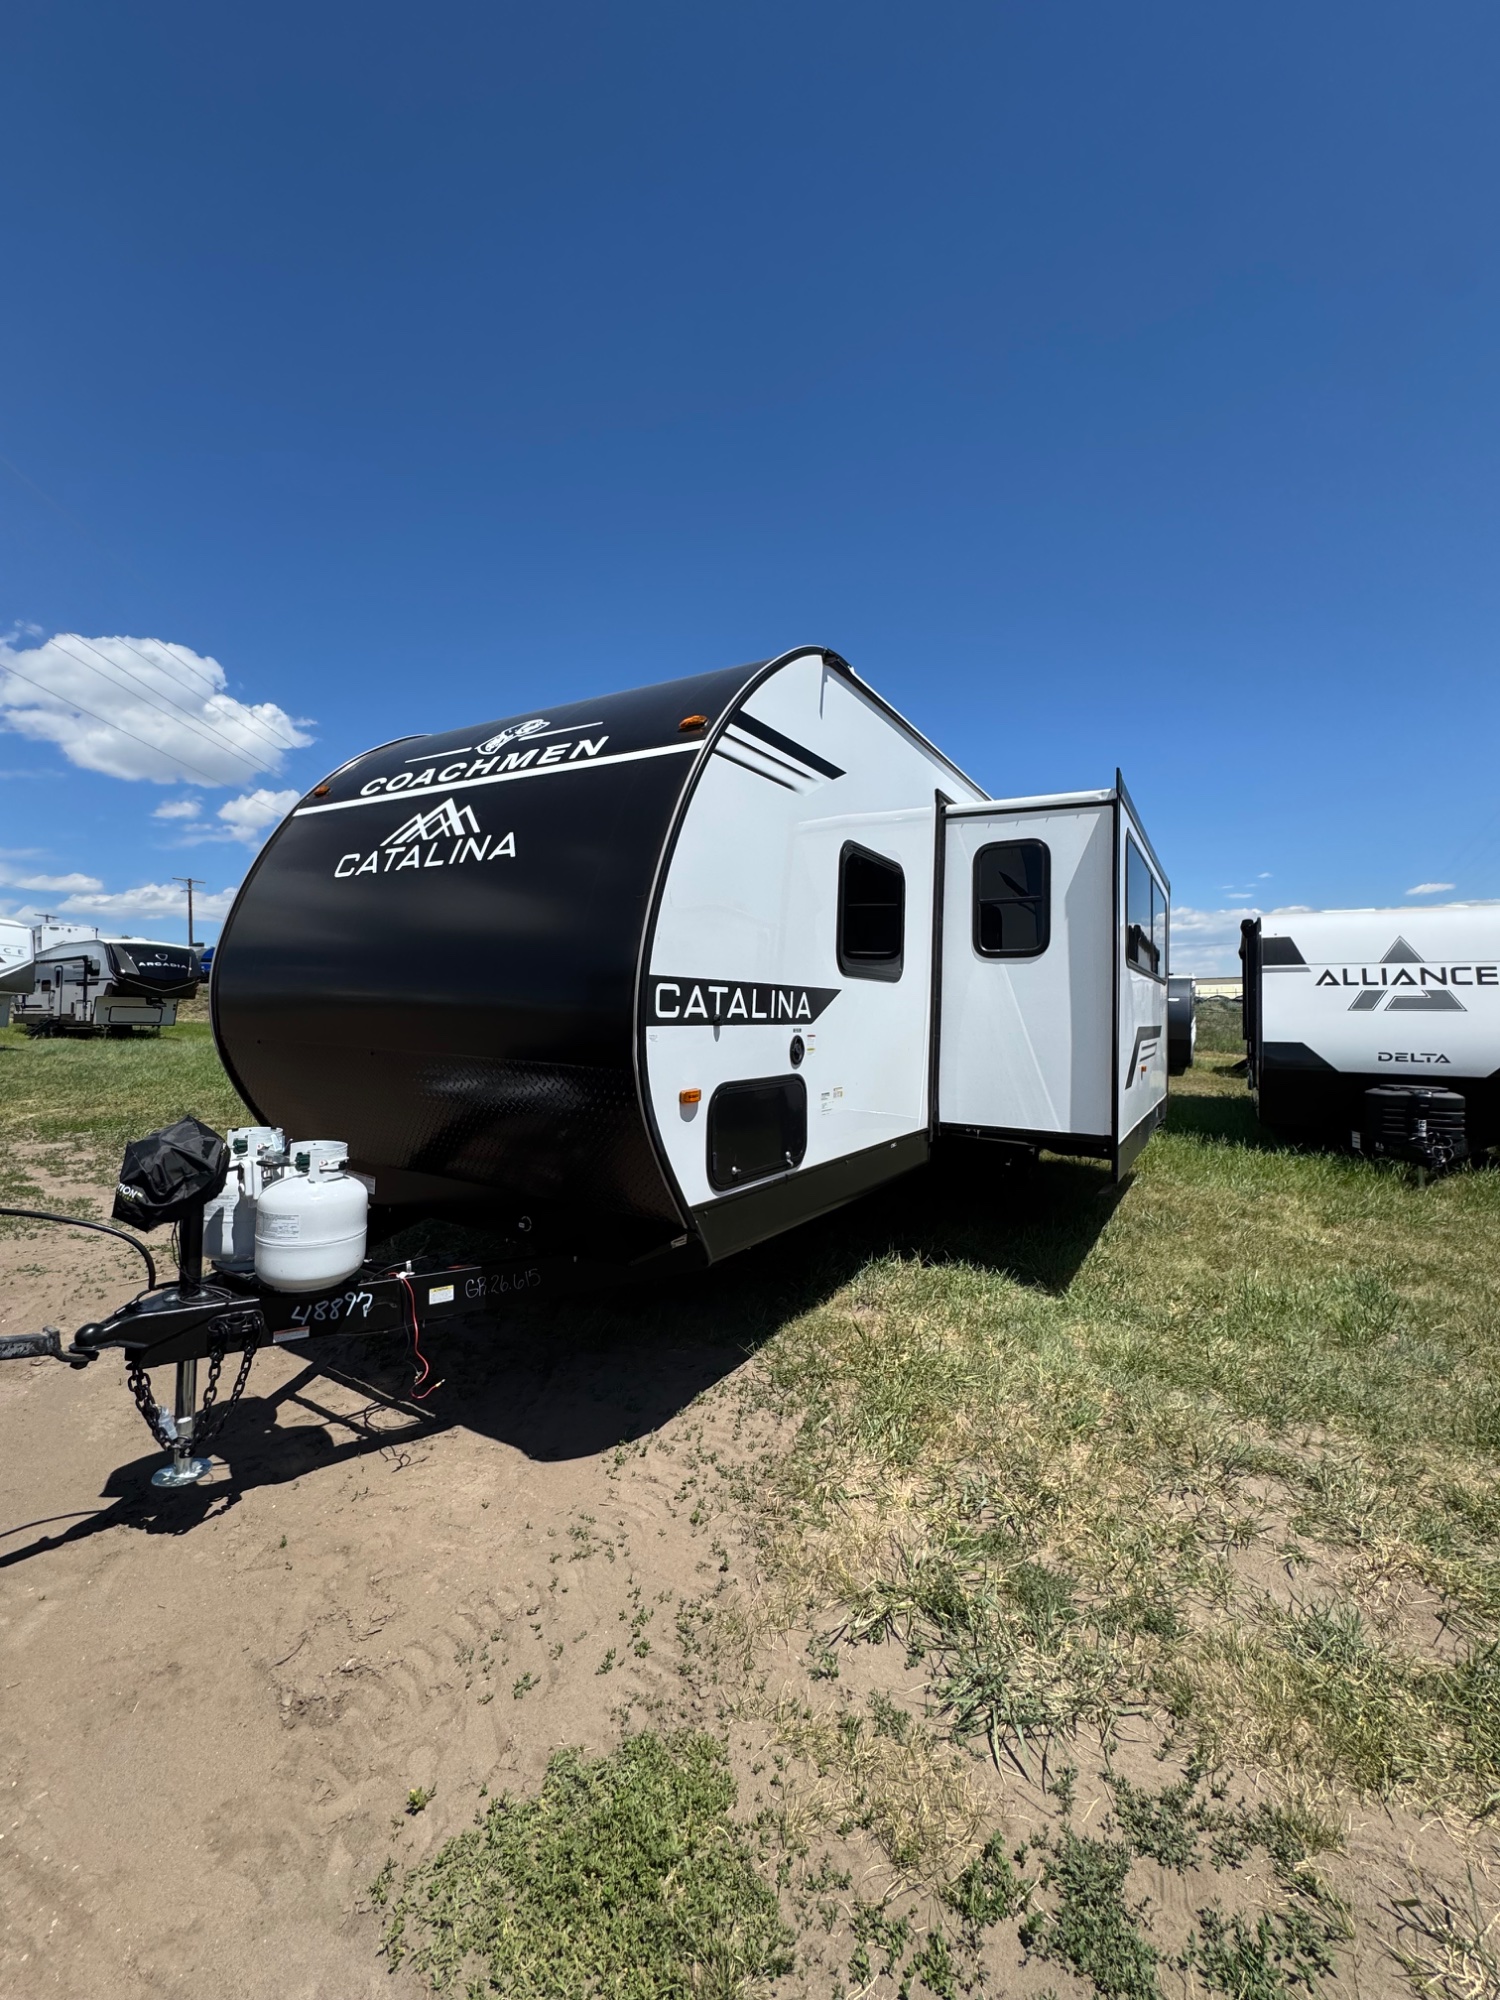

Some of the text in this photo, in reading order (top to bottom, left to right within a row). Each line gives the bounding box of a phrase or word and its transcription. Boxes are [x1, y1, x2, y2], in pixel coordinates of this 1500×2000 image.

[360, 736, 609, 796] COACHMEN
[334, 832, 516, 878] CATALINA
[138, 961, 188, 969] ARCADIA
[1315, 966, 1499, 986] ALLIANCE
[655, 983, 812, 1019] CATALINA
[1377, 1052, 1451, 1064] DELTA
